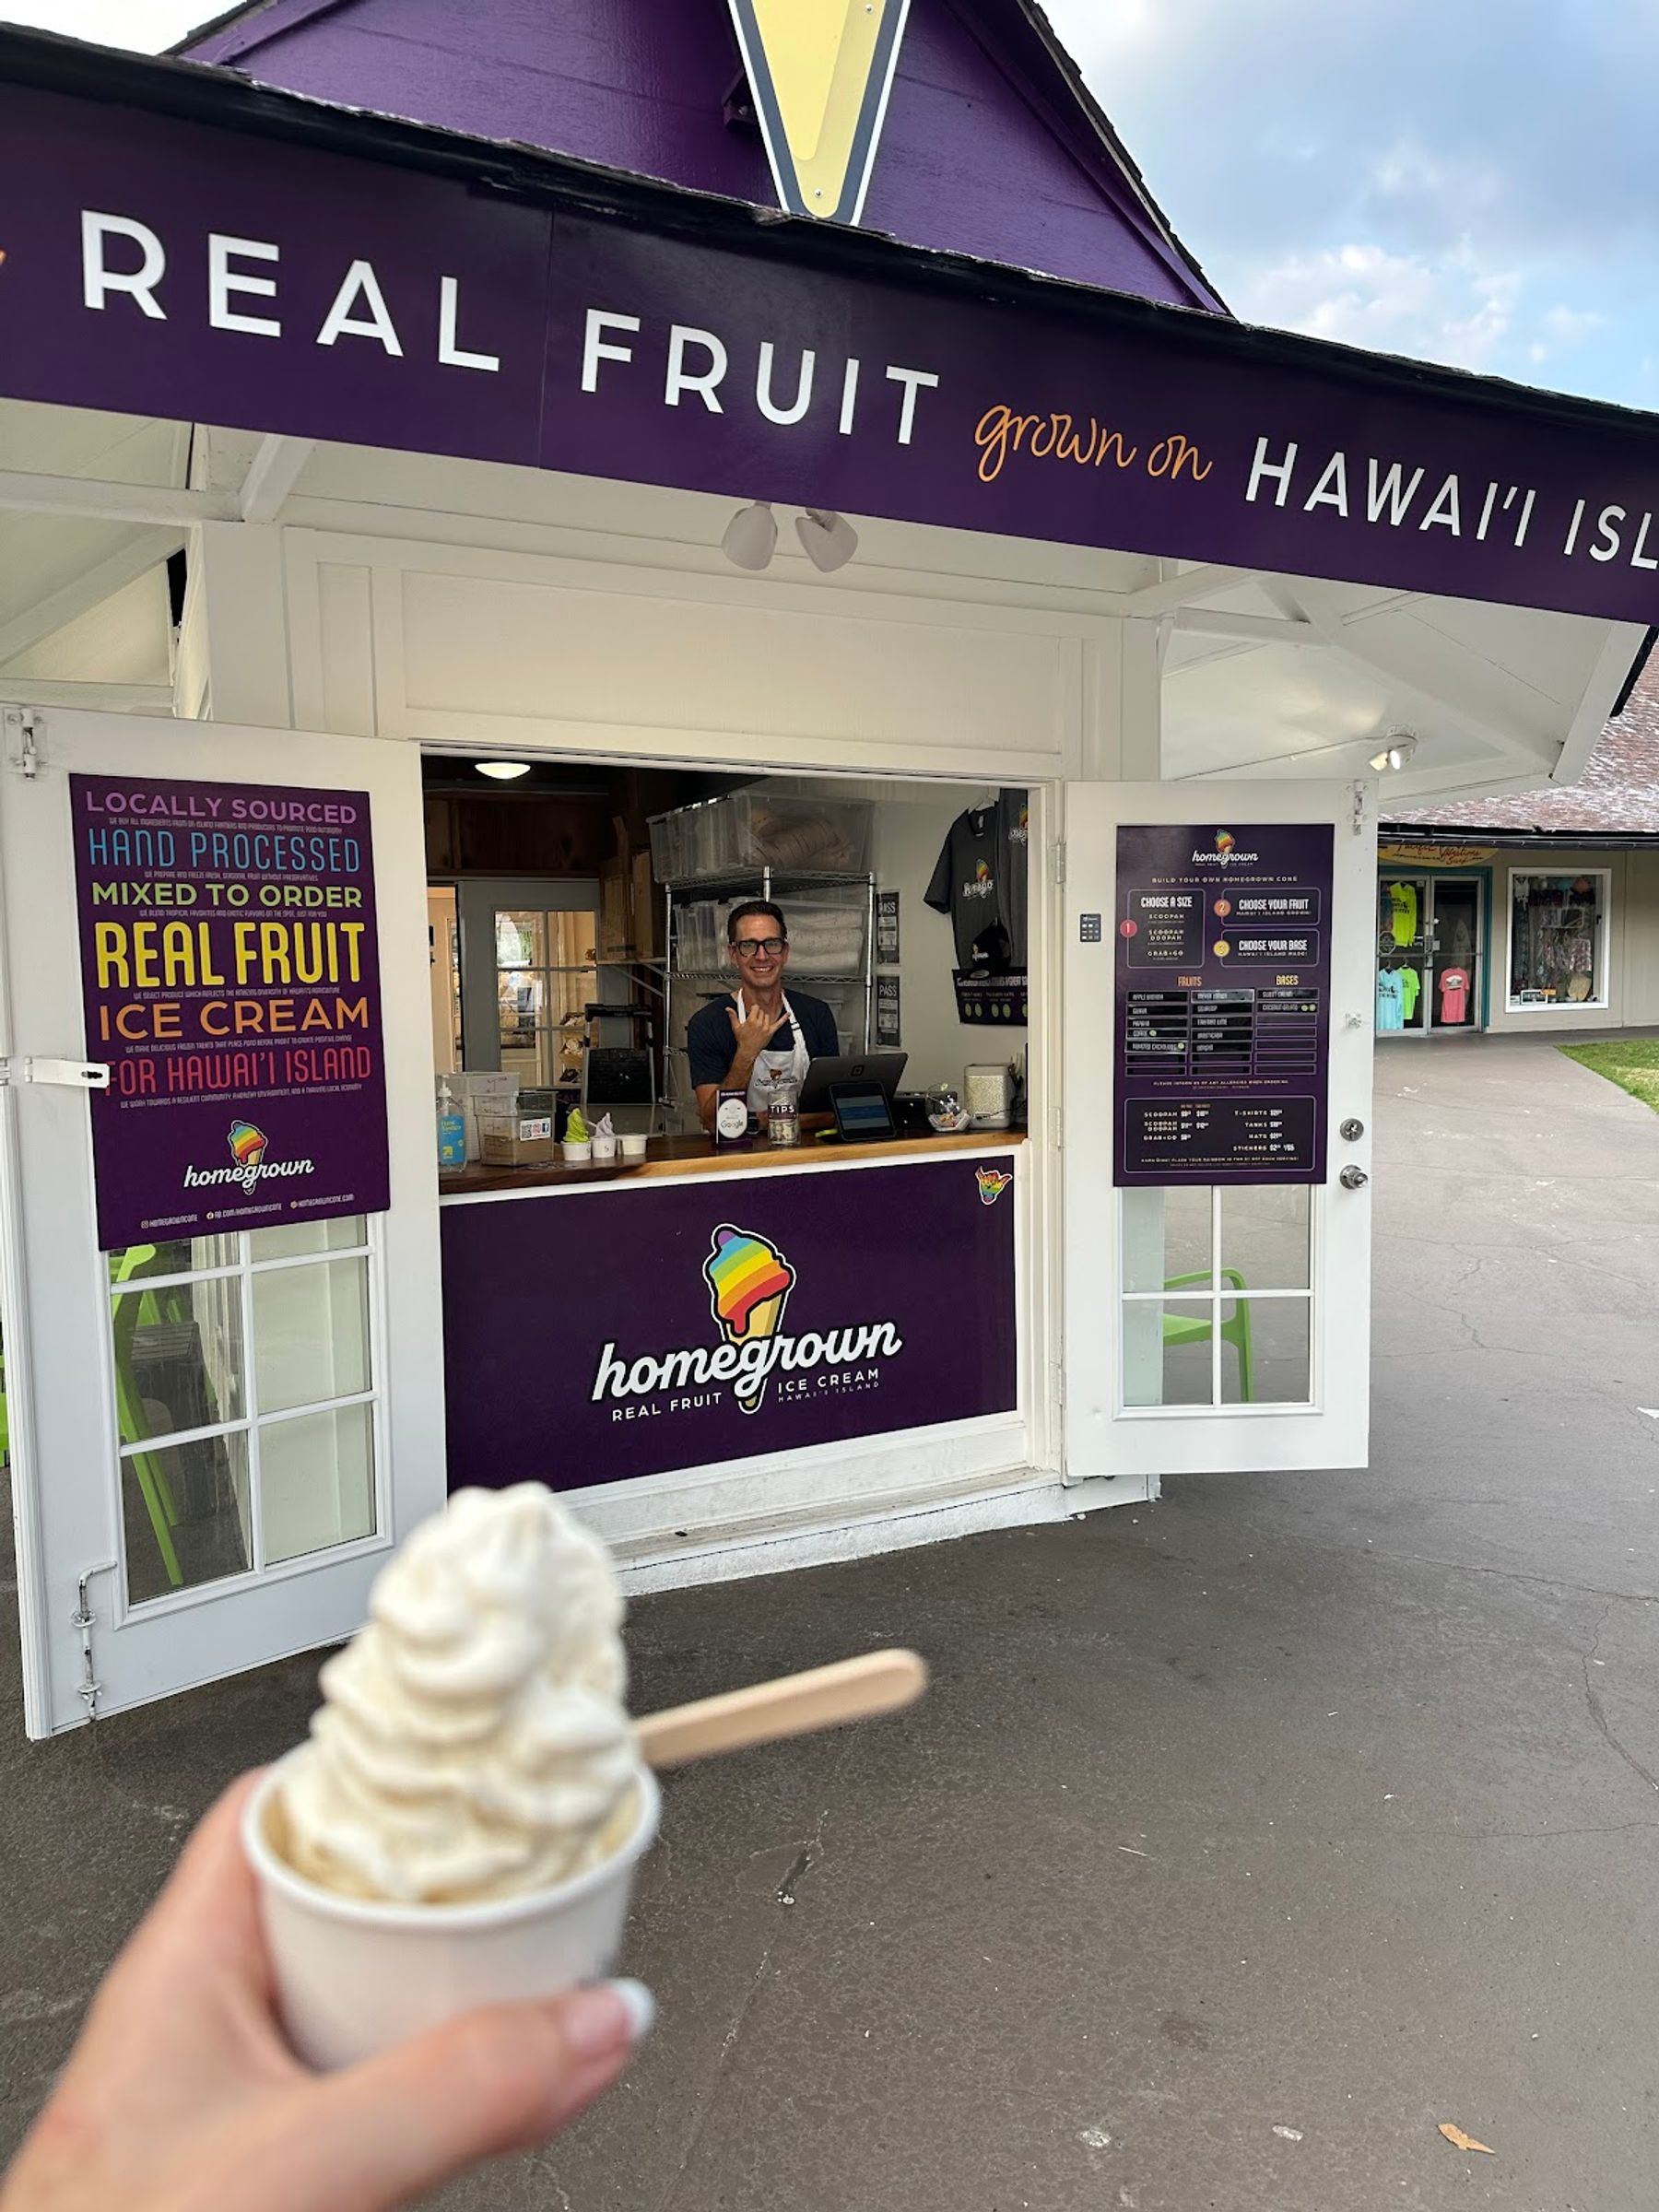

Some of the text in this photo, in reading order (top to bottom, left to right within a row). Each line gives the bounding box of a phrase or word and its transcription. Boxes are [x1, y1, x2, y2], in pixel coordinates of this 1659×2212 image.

[81, 209, 500, 371] REAL
[581, 308, 939, 445] FRUIT
[974, 405, 1137, 482] grown
[1147, 434, 1213, 481] on
[1245, 436, 1535, 547] HAWAI'I
[86, 791, 357, 824] LOCALLY SOURCED
[88, 828, 360, 873] HAND PROCESSED
[1192, 850, 1259, 865] homegrown
[92, 882, 362, 908] MIXED TO ORDER
[1141, 896, 1193, 908] CHOOSE A SIZE
[1220, 902, 1225, 912] 2
[1239, 899, 1309, 910] CHOOSE YOUR FRUIT
[1126, 923, 1130, 934] 1
[95, 921, 365, 988] REAL FRUIT
[1239, 940, 1307, 950] CHOOSE YOUR BASE
[879, 985, 897, 996] PASS
[1178, 976, 1202, 986] FRUITS
[1276, 975, 1299, 985] BASES
[99, 996, 369, 1041] ICE CREAM
[105, 1046, 371, 1097] FOR HAWAI'I ISLAND
[721, 1120, 743, 1129] Google
[183, 1159, 314, 1188] homegrown
[592, 1321, 903, 1401] homegrown
[778, 1368, 879, 1394] ICE CREAM
[612, 1392, 723, 1422] REAL FRUIT
